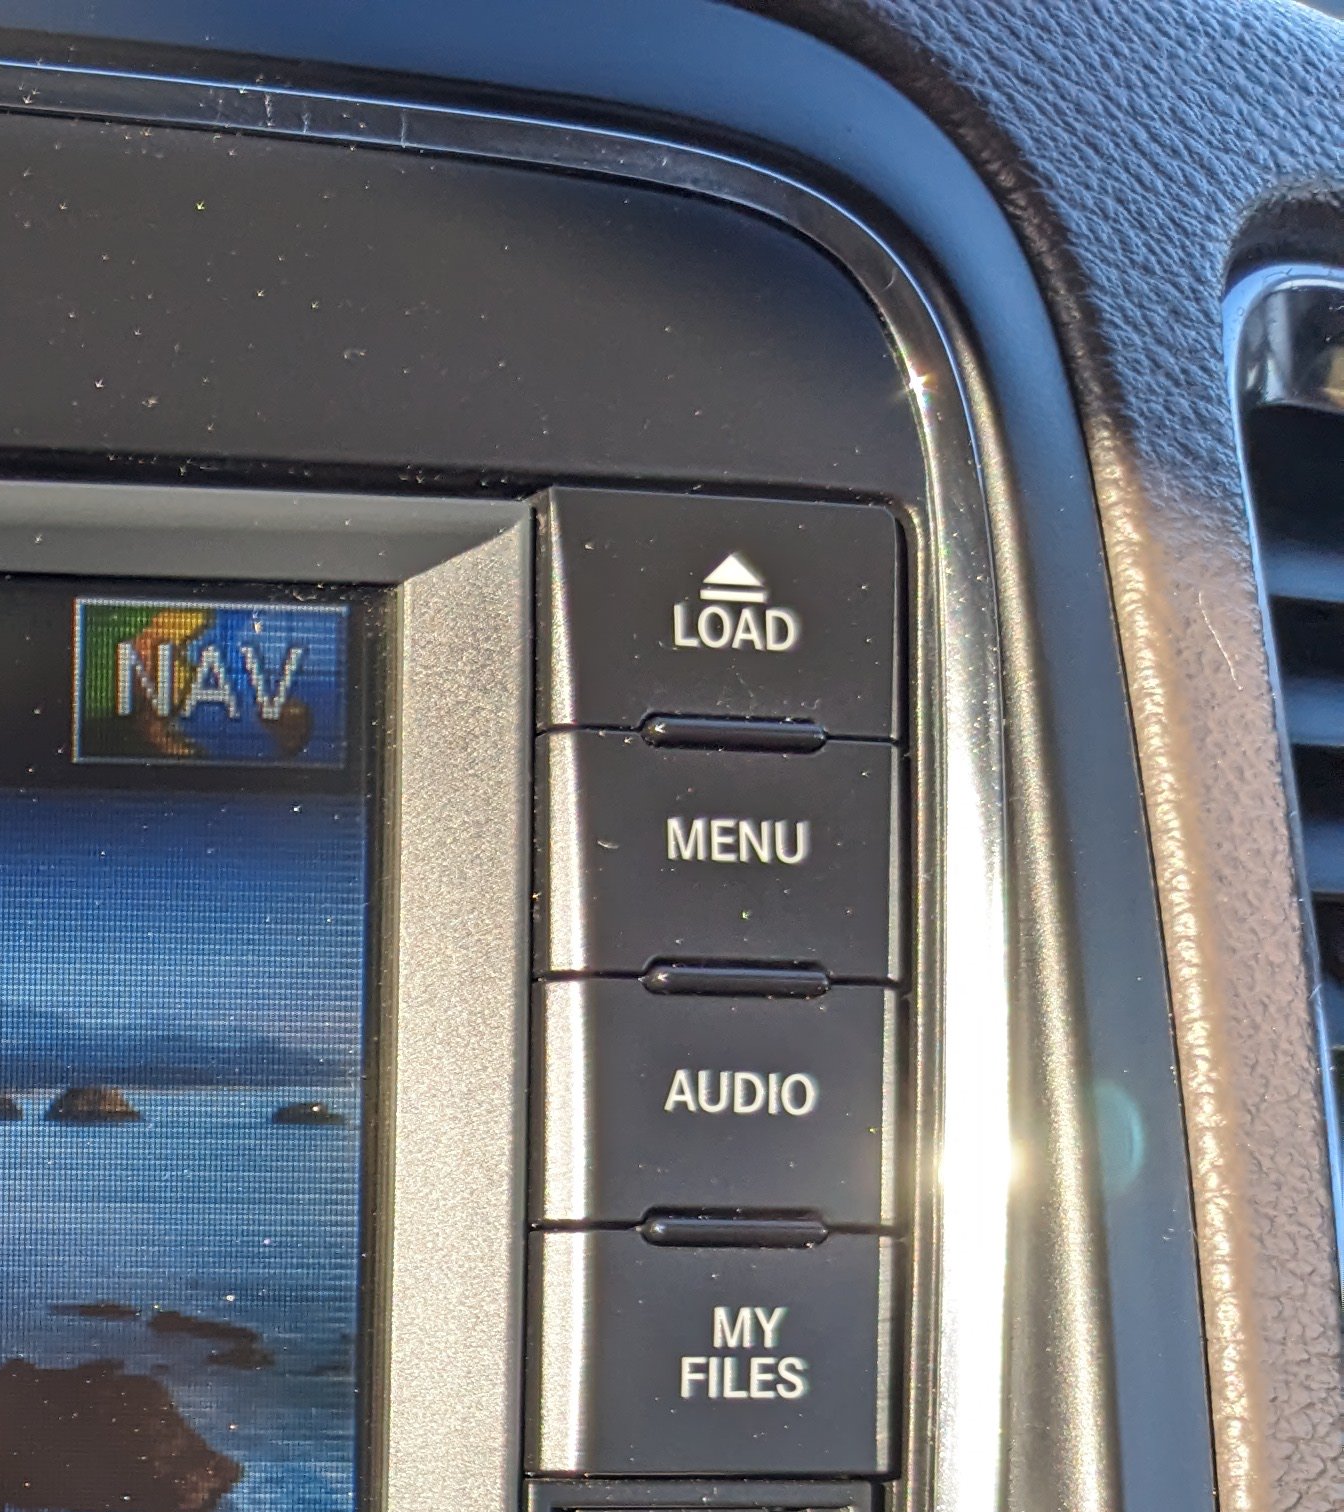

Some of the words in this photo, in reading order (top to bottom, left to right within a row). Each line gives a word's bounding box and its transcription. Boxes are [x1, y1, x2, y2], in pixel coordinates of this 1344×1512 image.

[673, 603, 796, 652] LOAD
[116, 639, 303, 721] NAV
[666, 818, 809, 864] MENU
[664, 1068, 816, 1116] AUDIO
[713, 1306, 785, 1348] MY
[680, 1356, 807, 1399] FILES
